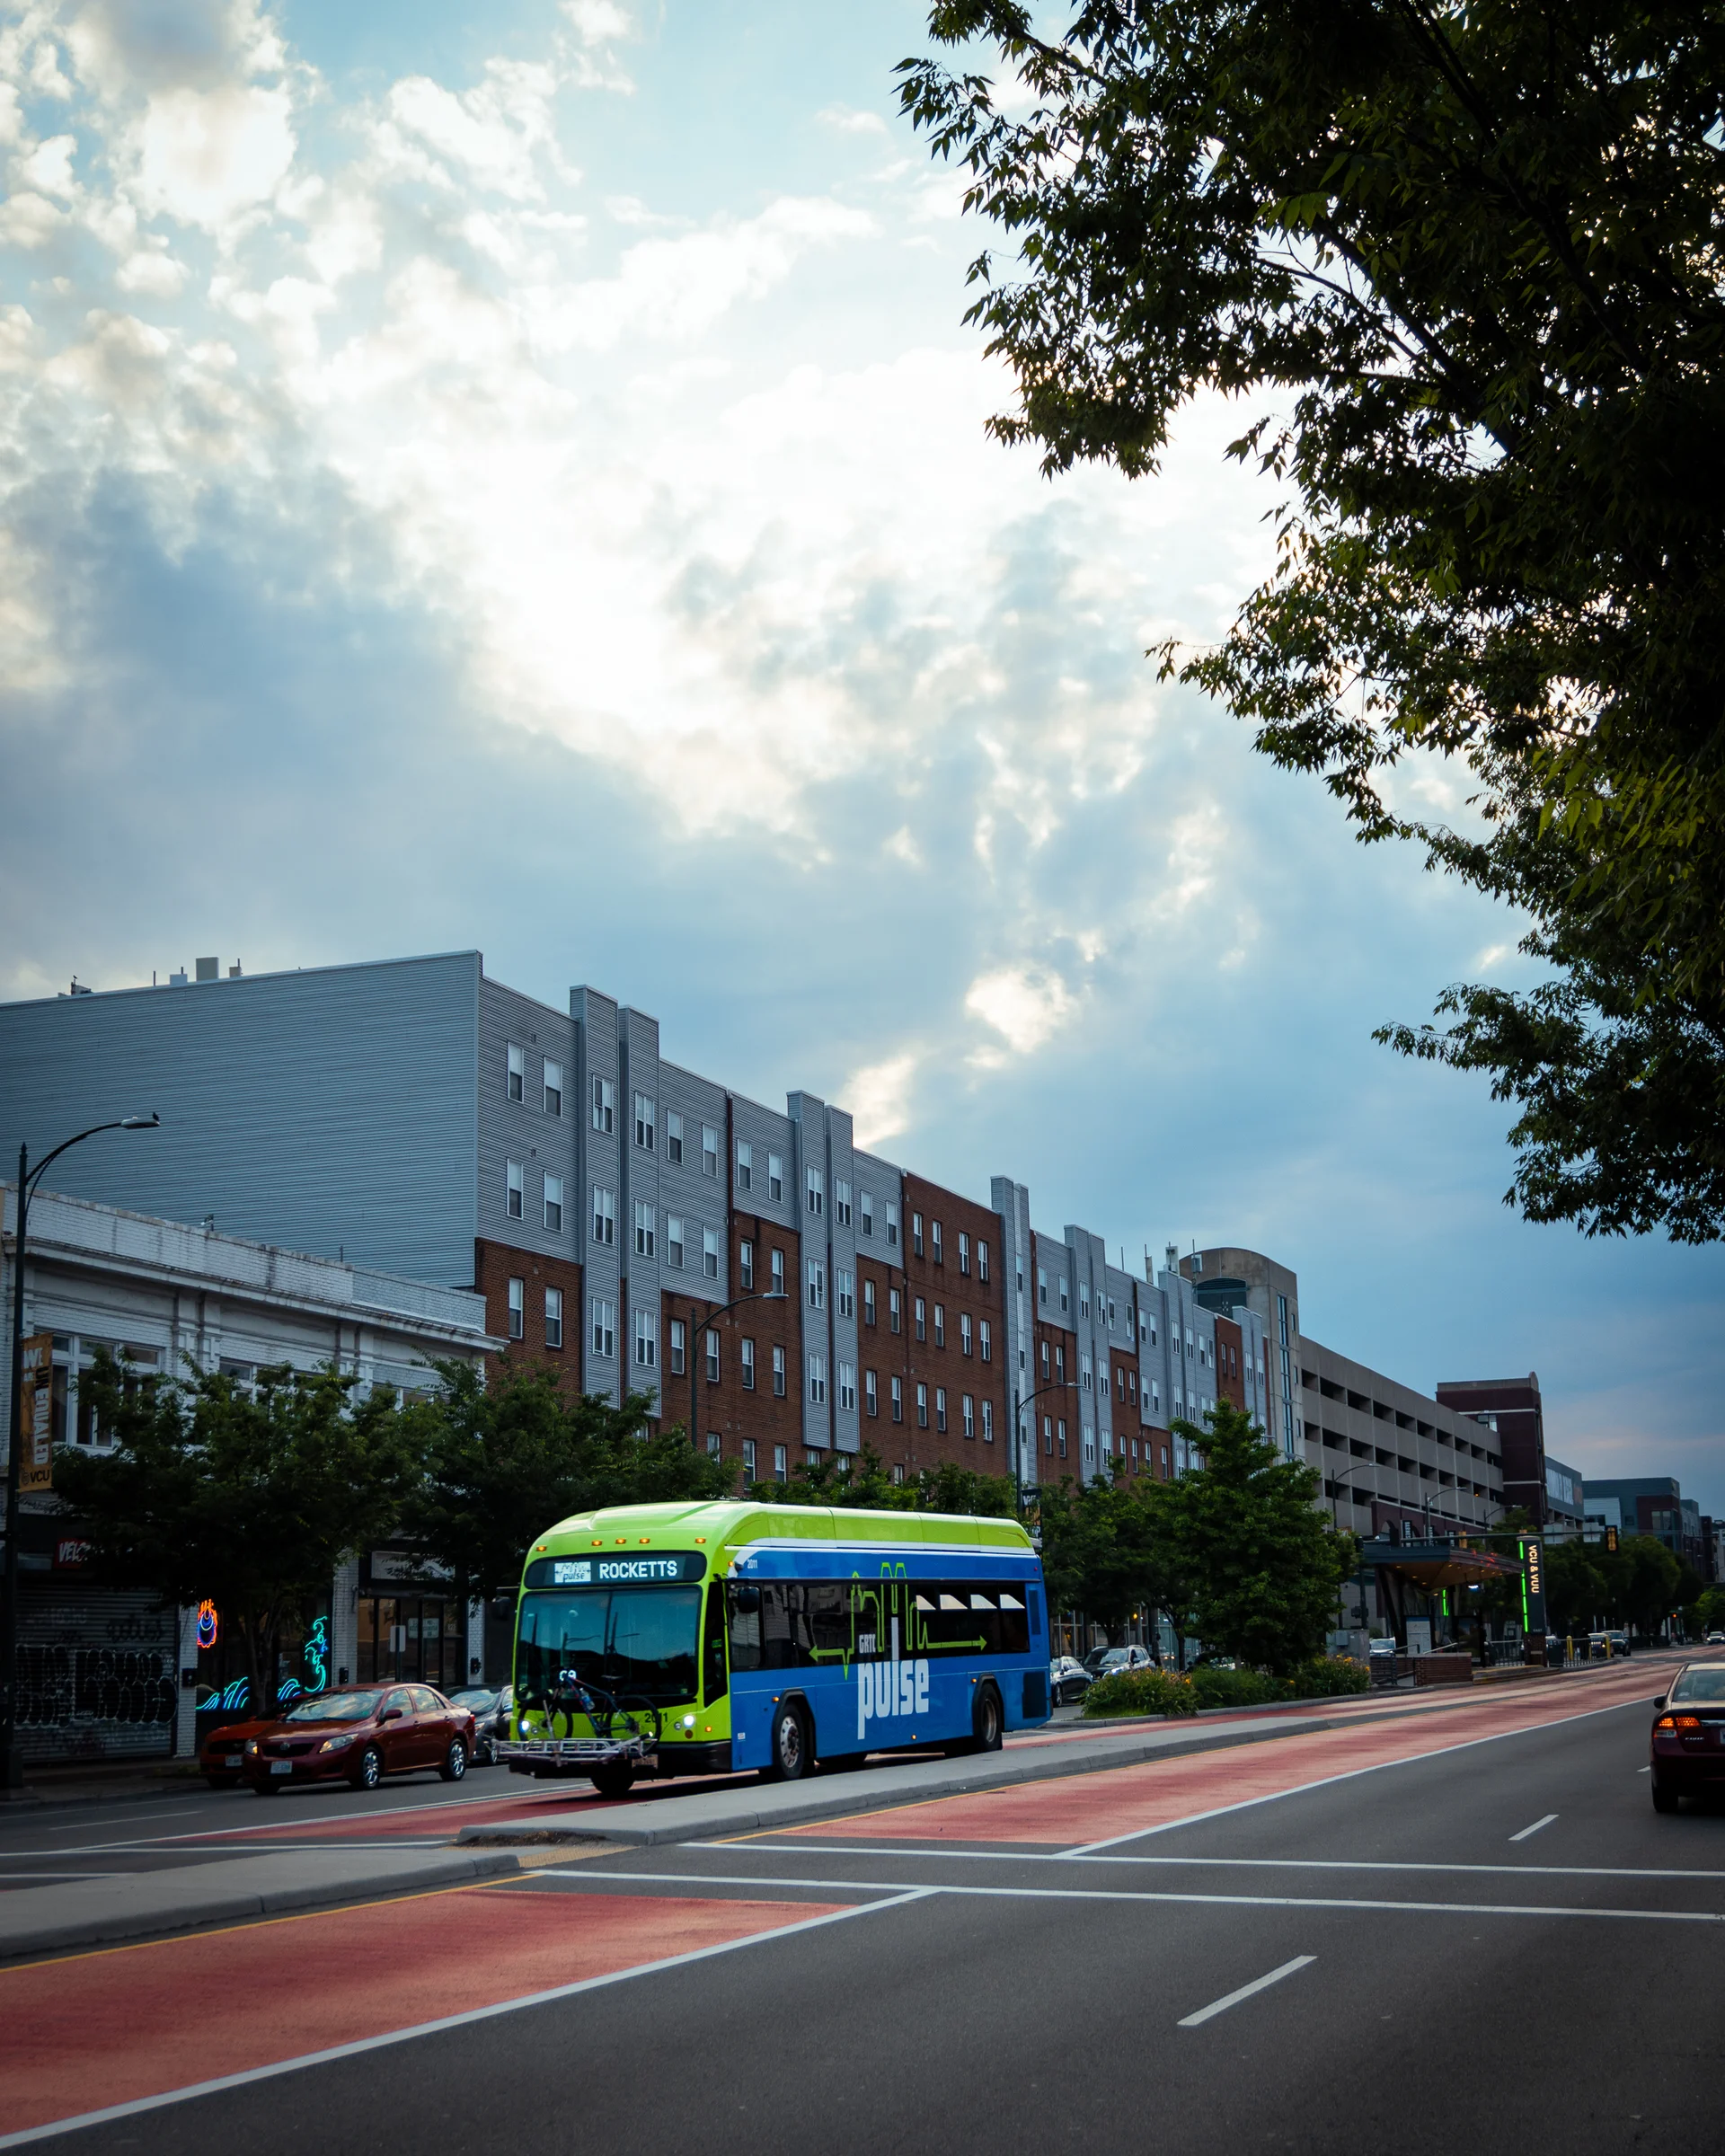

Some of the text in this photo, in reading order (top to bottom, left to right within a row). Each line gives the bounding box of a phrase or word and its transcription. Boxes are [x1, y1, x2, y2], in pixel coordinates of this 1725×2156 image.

[23, 1348, 44, 1369] WE
[33, 1365, 49, 1465] UNEQUALED
[30, 1469, 50, 1483] VCU
[1528, 1544, 1538, 1563] VCU
[562, 1560, 678, 1583] pulse ROCKETTS
[747, 1559, 758, 1569] 2011
[1530, 1574, 1540, 1594] VUU
[858, 1633, 877, 1654] GRTC
[857, 1617, 930, 1740] pulse
[644, 1712, 668, 1723] 2011
